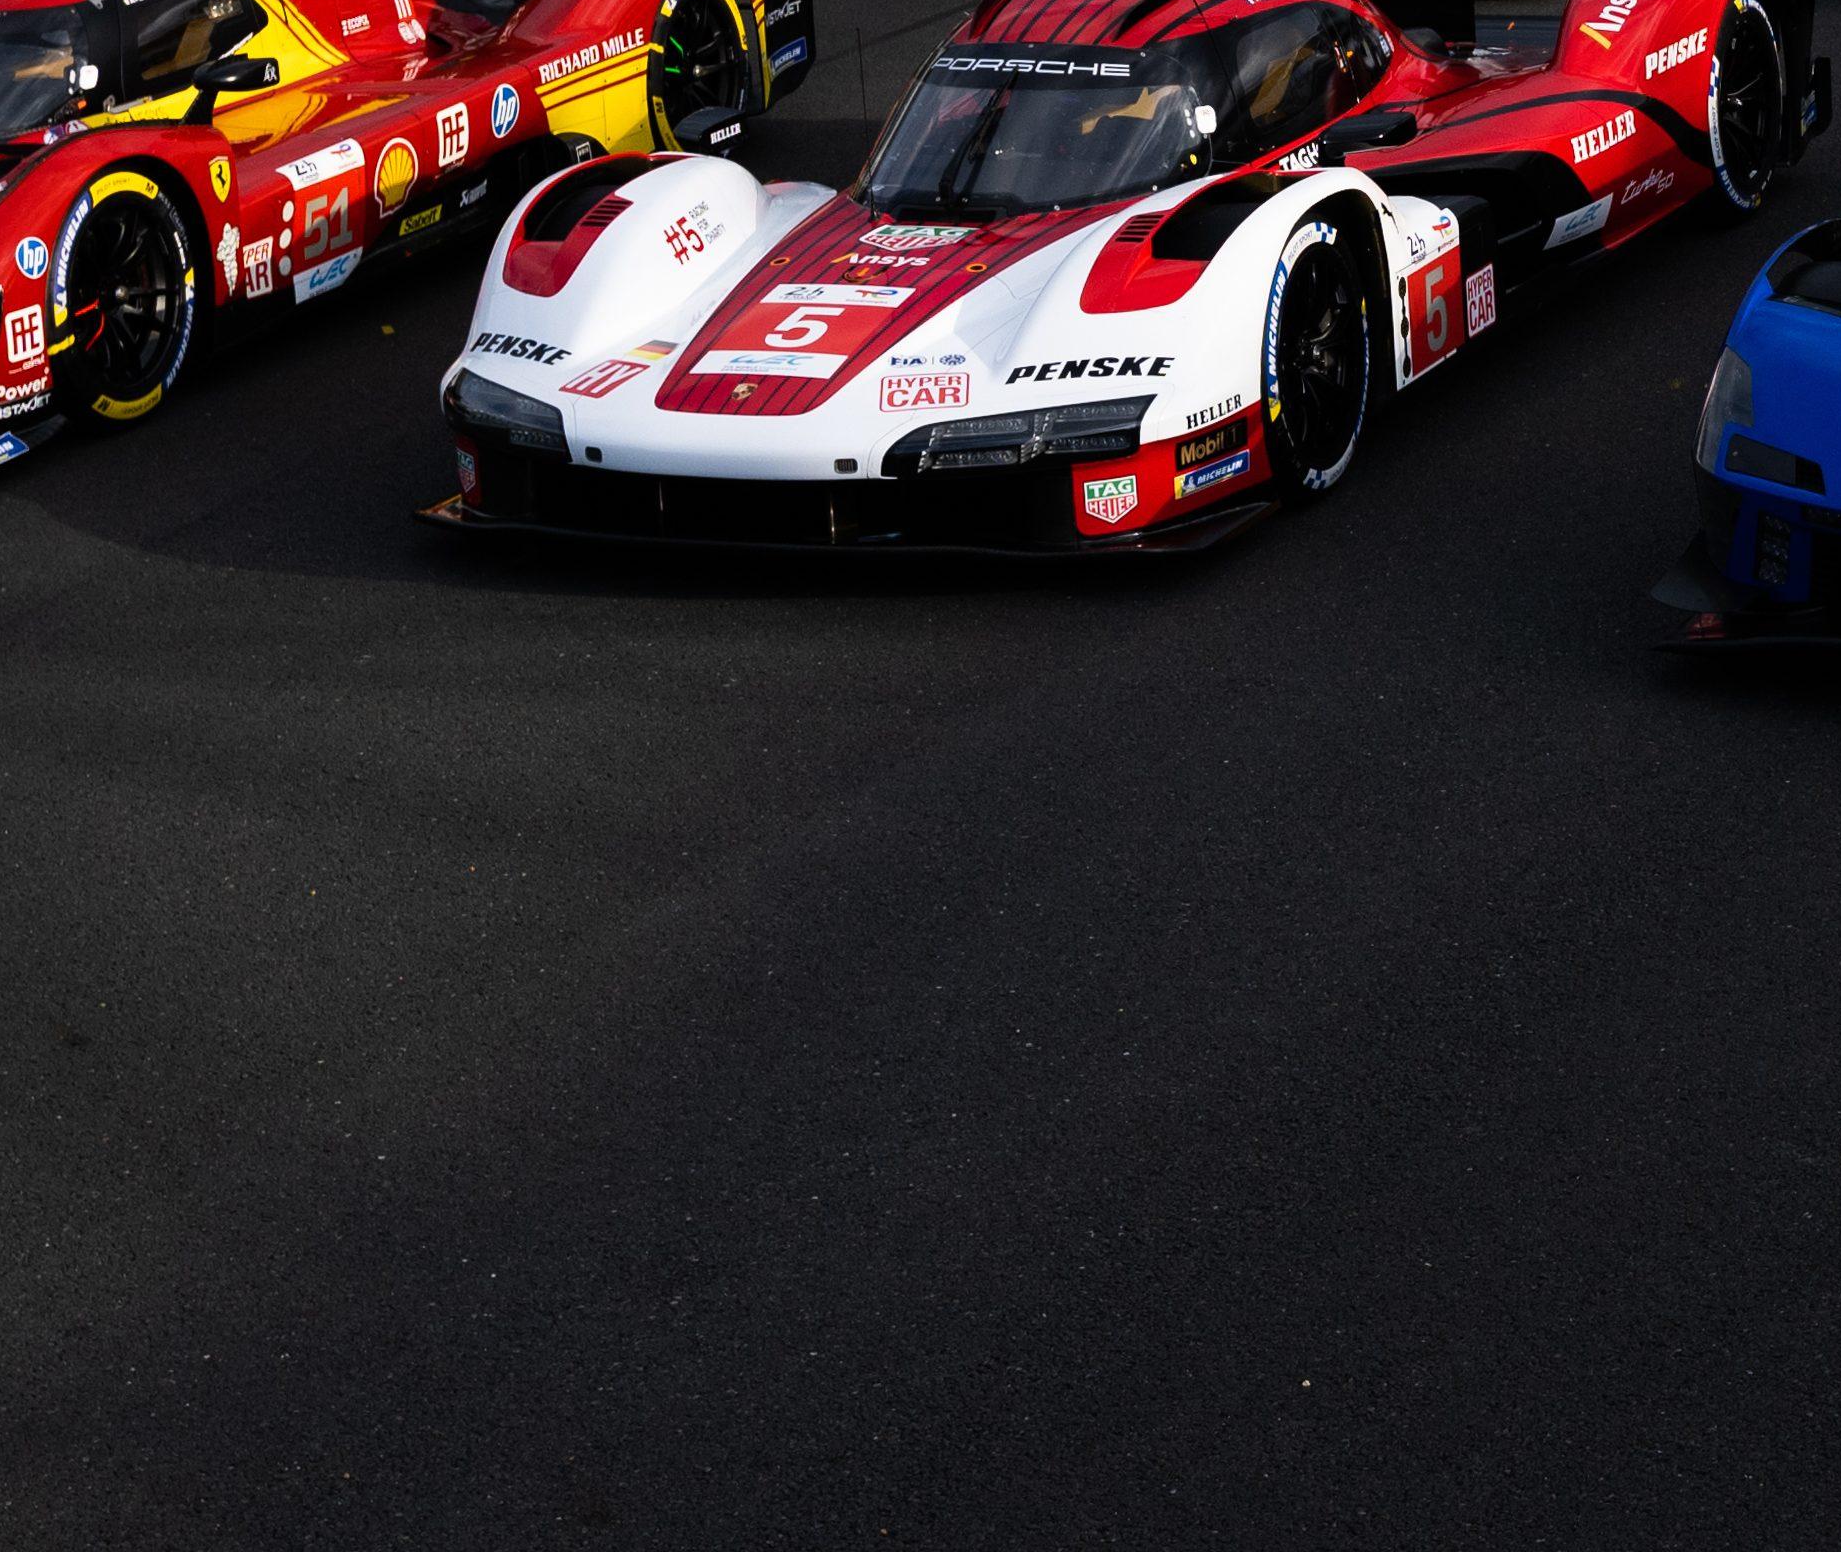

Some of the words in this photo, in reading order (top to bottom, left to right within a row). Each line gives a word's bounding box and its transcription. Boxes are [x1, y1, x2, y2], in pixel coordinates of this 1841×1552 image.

[539, 42, 601, 84] RICHARD
[602, 27, 646, 61] MILLE
[931, 57, 1132, 78] PORSCHE
[1644, 27, 1709, 81] PENSKE
[495, 89, 519, 135] hp
[708, 122, 743, 145] HELLER
[1570, 109, 1637, 165] HELLER
[302, 186, 354, 260] 51
[403, 206, 440, 234] Sabelt
[20, 239, 45, 274] hp
[56, 198, 90, 290] MICHELIN
[662, 215, 706, 266] #5
[869, 234, 958, 250] HEUER
[830, 251, 931, 267] Ansys
[1467, 268, 1494, 302] HYPER
[1267, 269, 1287, 377] MICHELIN
[1425, 264, 1449, 353] 5
[1468, 290, 1495, 332] CAR
[764, 306, 846, 349] 5
[469, 332, 573, 366] PENSKE
[888, 355, 926, 366] FIA
[564, 361, 646, 394] HY
[887, 375, 963, 390] HYPER
[1005, 356, 1175, 385] PENSKE
[886, 386, 962, 408] CAR
[1185, 393, 1243, 430] HELLER
[1089, 479, 1134, 497] TAG
[1196, 458, 1245, 487] MICHELIN
[1087, 496, 1136, 518] HEUER
